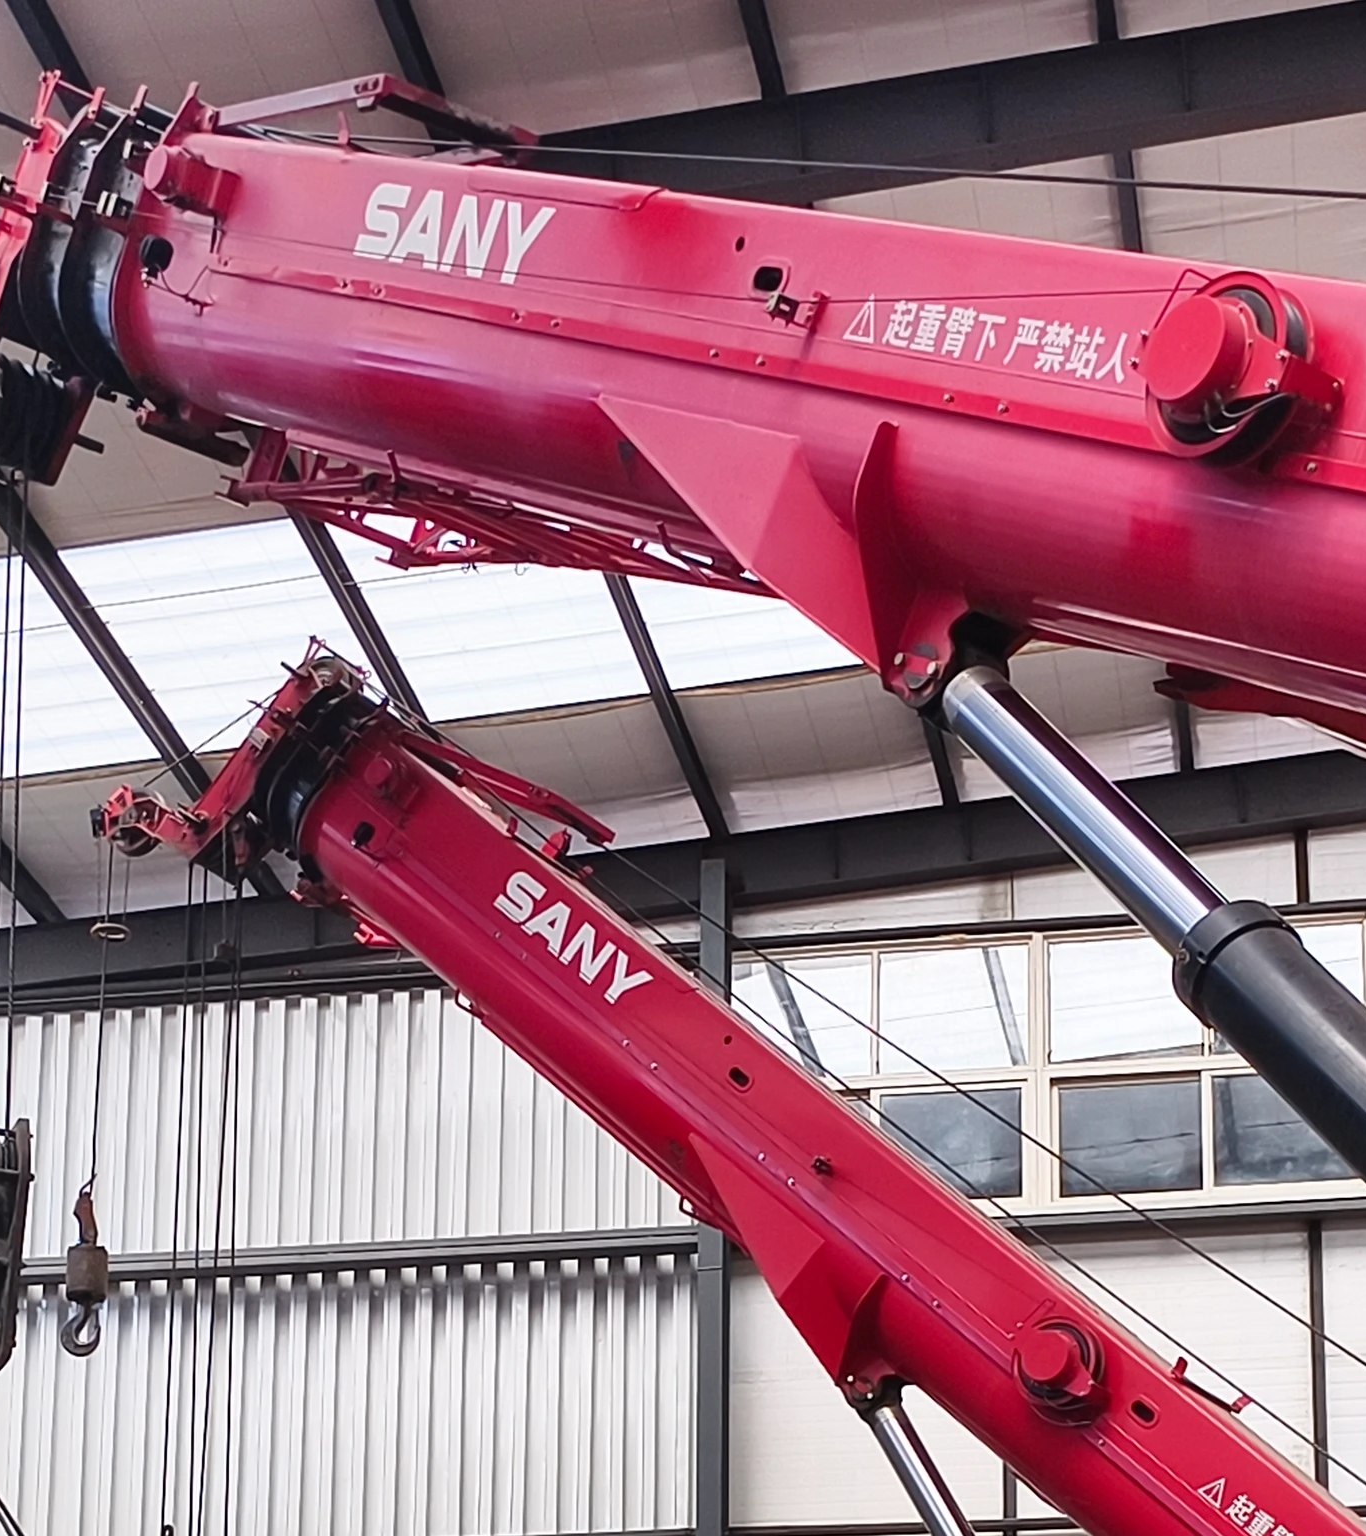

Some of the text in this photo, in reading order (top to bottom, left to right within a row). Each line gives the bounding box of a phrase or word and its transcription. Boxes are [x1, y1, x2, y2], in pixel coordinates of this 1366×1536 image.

[353, 182, 557, 285] SANY
[882, 299, 1129, 384] 起重臂下 严禁站人
[493, 871, 653, 1004] SANY
